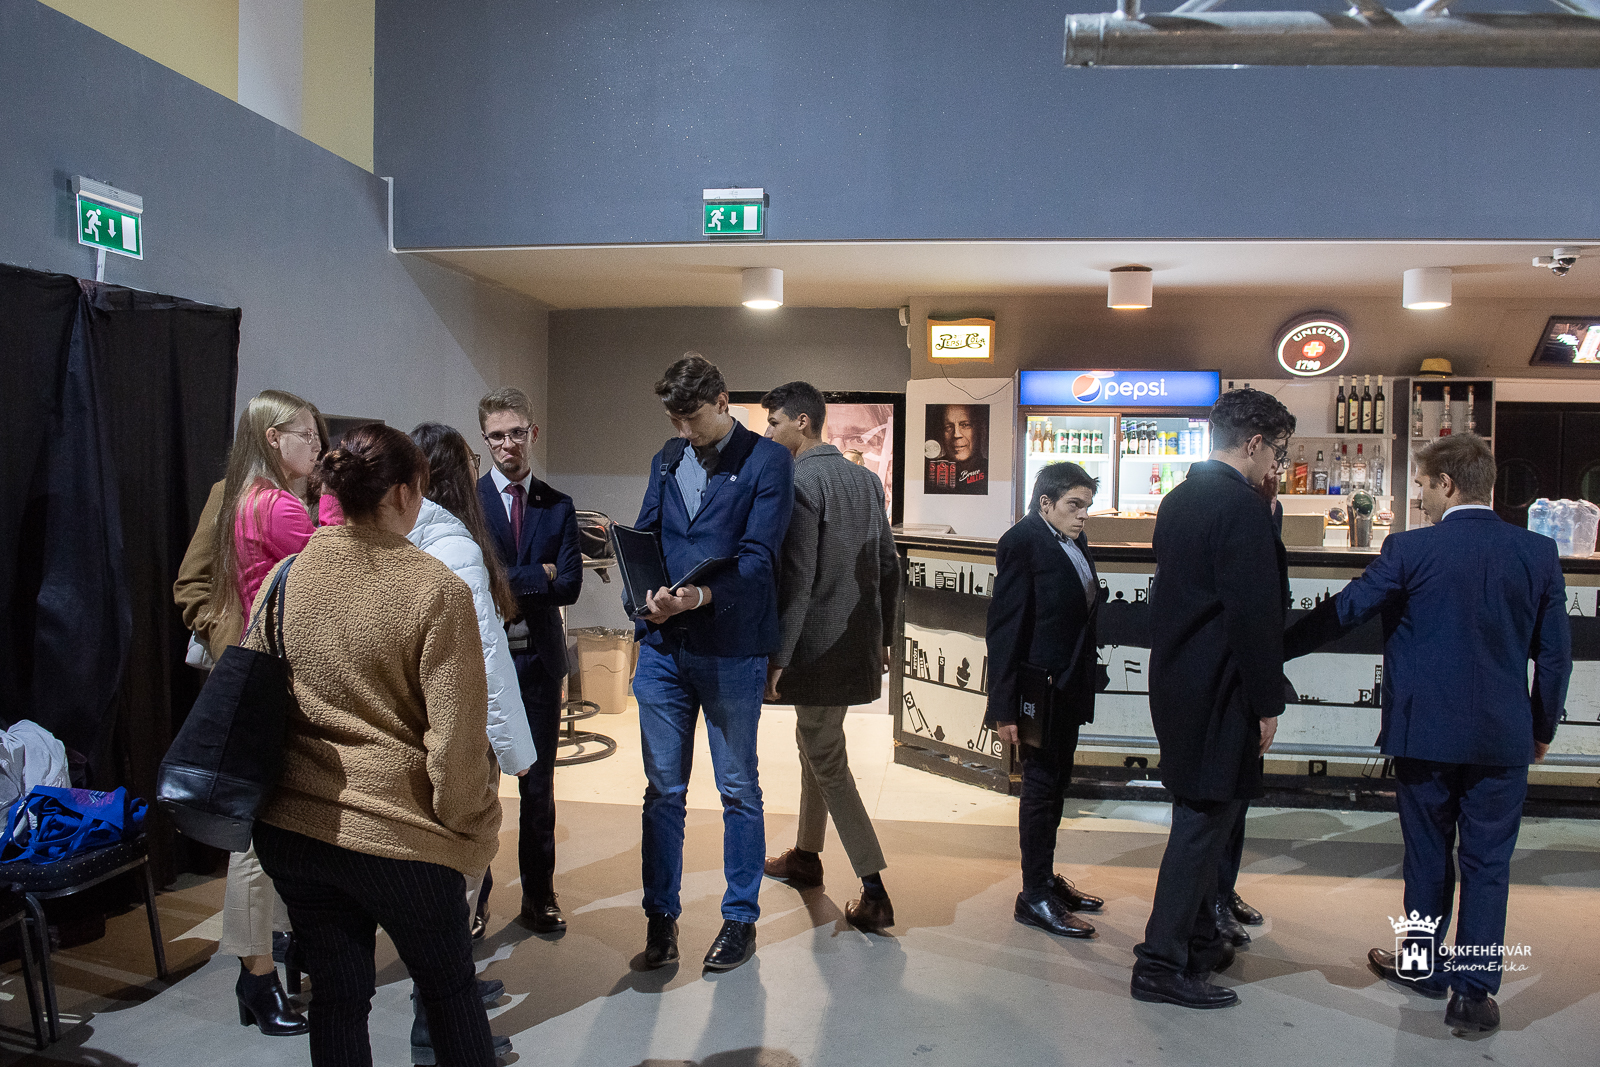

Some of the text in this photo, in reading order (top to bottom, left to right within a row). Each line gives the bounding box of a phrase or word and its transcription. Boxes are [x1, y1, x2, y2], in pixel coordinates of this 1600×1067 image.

[1292, 327, 1342, 343] UNICUM
[1295, 359, 1321, 370] 1790
[1104, 378, 1168, 401] pepsi
[966, 472, 985, 484] WILLIS
